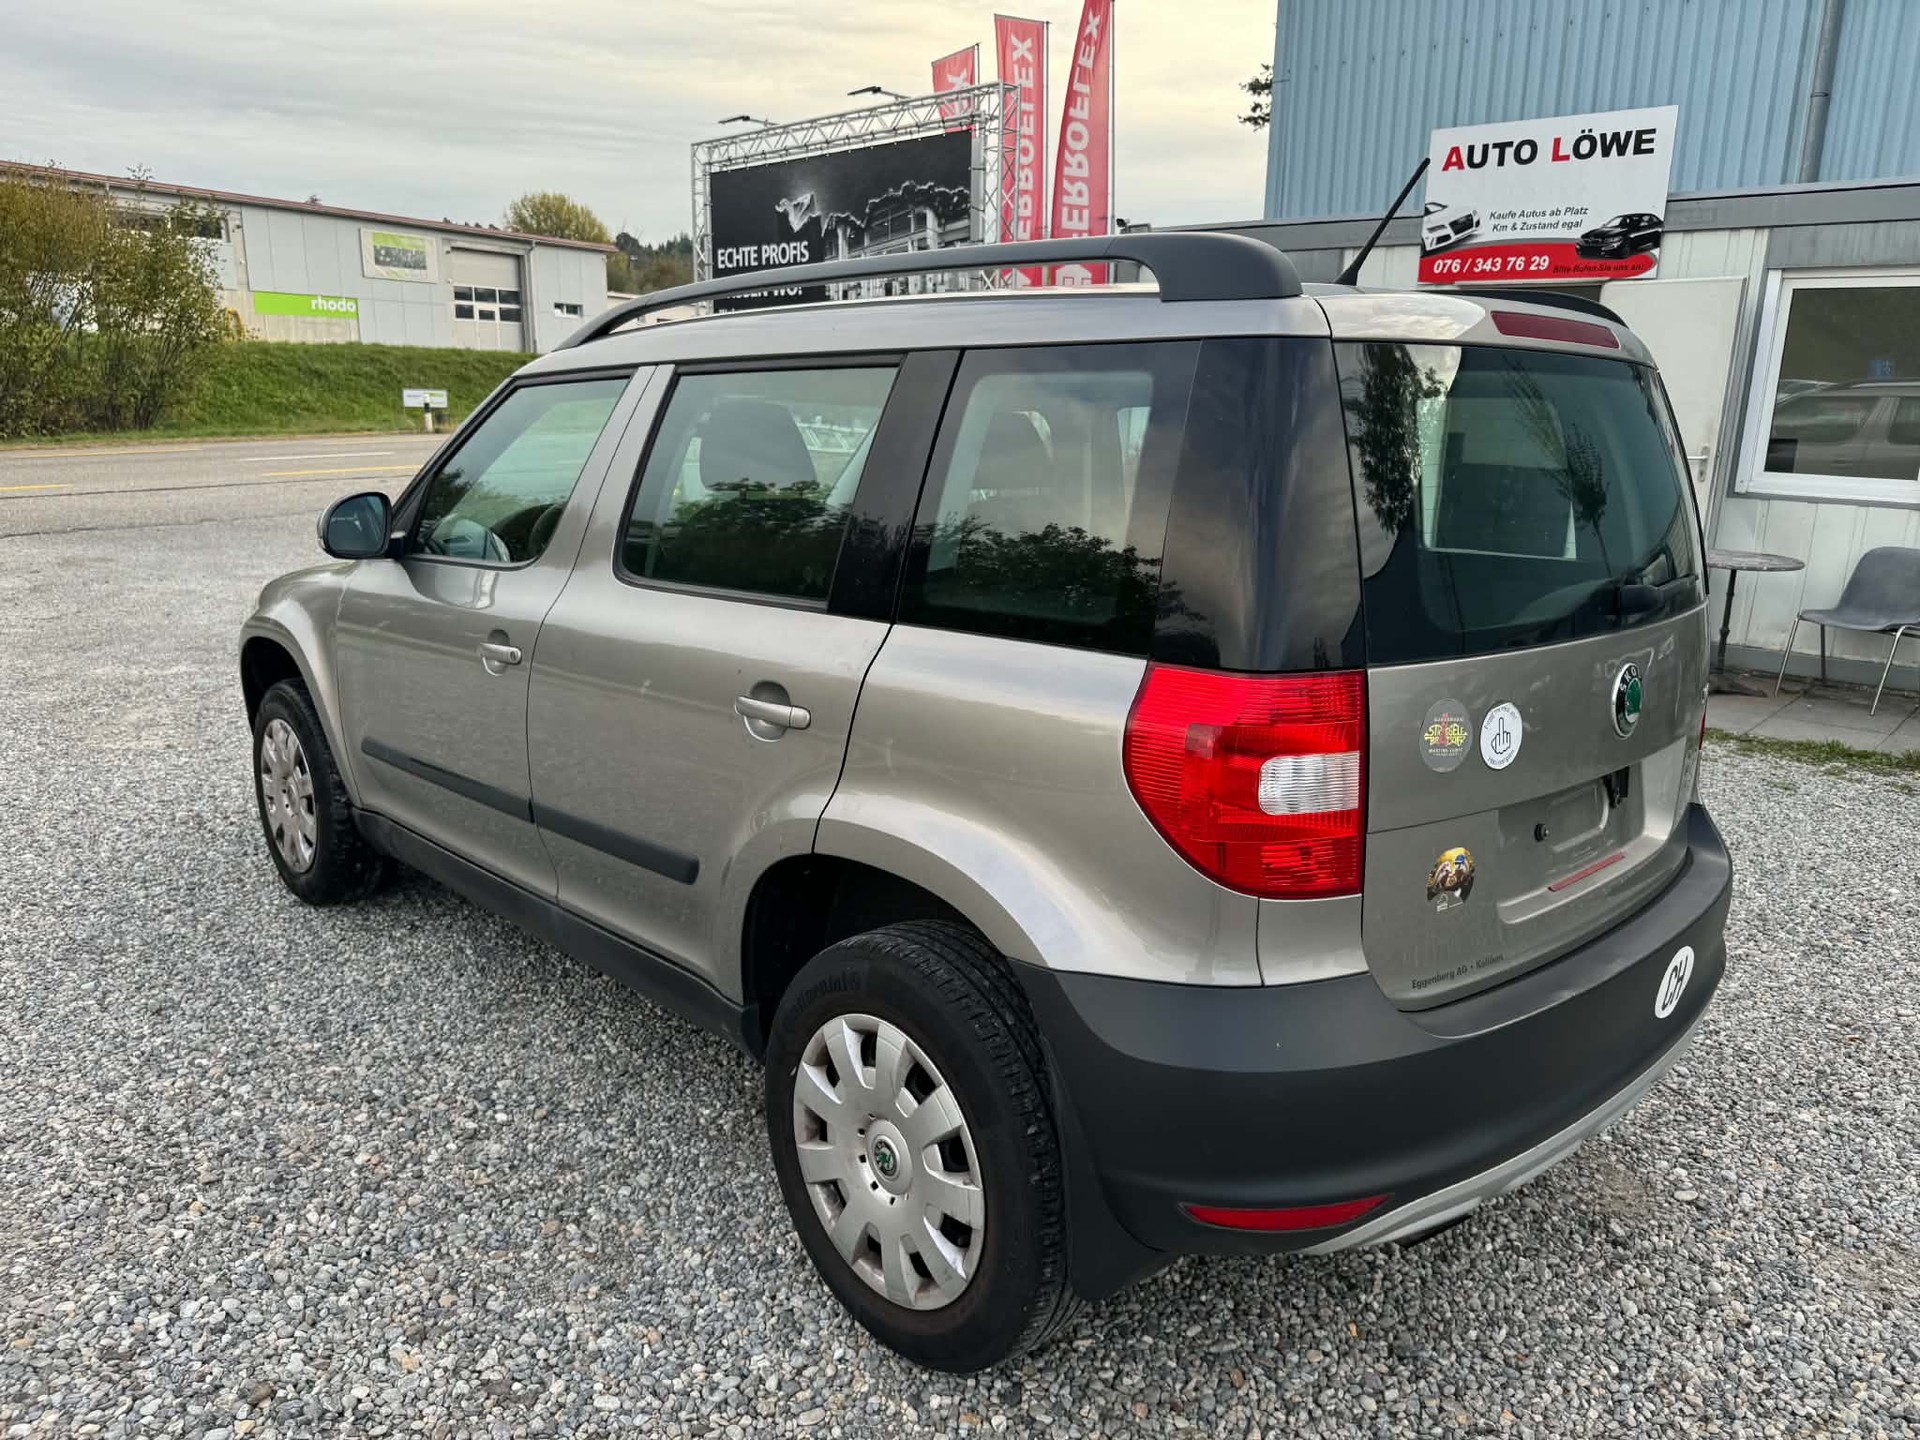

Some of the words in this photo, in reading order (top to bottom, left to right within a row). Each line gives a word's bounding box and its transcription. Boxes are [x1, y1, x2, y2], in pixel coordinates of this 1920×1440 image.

[1441, 138, 1538, 172] AUTO
[1551, 128, 1656, 162] LÖWE
[1489, 210, 1516, 220] Kaufe
[1549, 208, 1562, 217] ab
[1564, 206, 1589, 216] Platz
[1492, 223, 1508, 232] Km
[1511, 223, 1518, 231] &
[1520, 221, 1559, 230] Zustand
[1561, 219, 1583, 231] egal
[717, 246, 758, 269] ECHTE
[761, 241, 810, 266] PROFIS
[1433, 258, 1461, 274] 076
[1463, 257, 1471, 273] /
[1473, 257, 1501, 273] 343
[1506, 256, 1525, 271] 76
[1530, 255, 1550, 270] 29
[311, 295, 357, 312] rhodo
[1662, 955, 1688, 1011] CH
